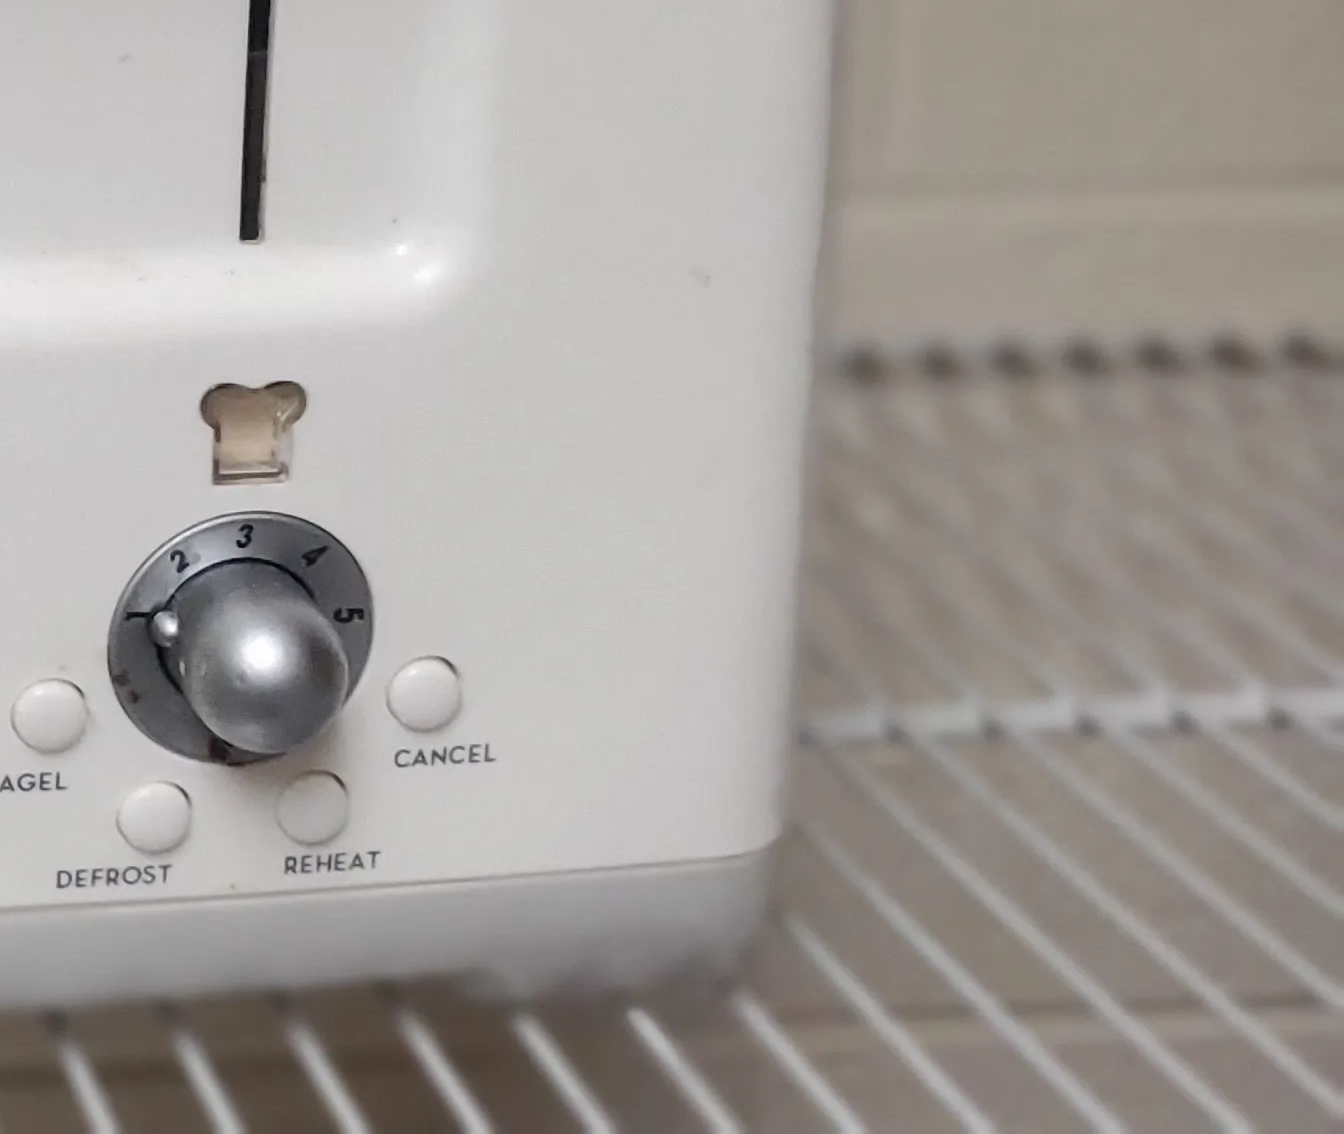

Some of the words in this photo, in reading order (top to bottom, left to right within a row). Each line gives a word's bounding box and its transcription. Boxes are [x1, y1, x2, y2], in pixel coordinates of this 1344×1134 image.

[169, 549, 190, 574] 2
[235, 523, 255, 549] 3
[300, 545, 329, 569] 4
[333, 607, 365, 624] 5
[394, 743, 496, 768] CANCEL
[284, 850, 382, 876] REHEAT
[56, 865, 173, 890] DEFROST
